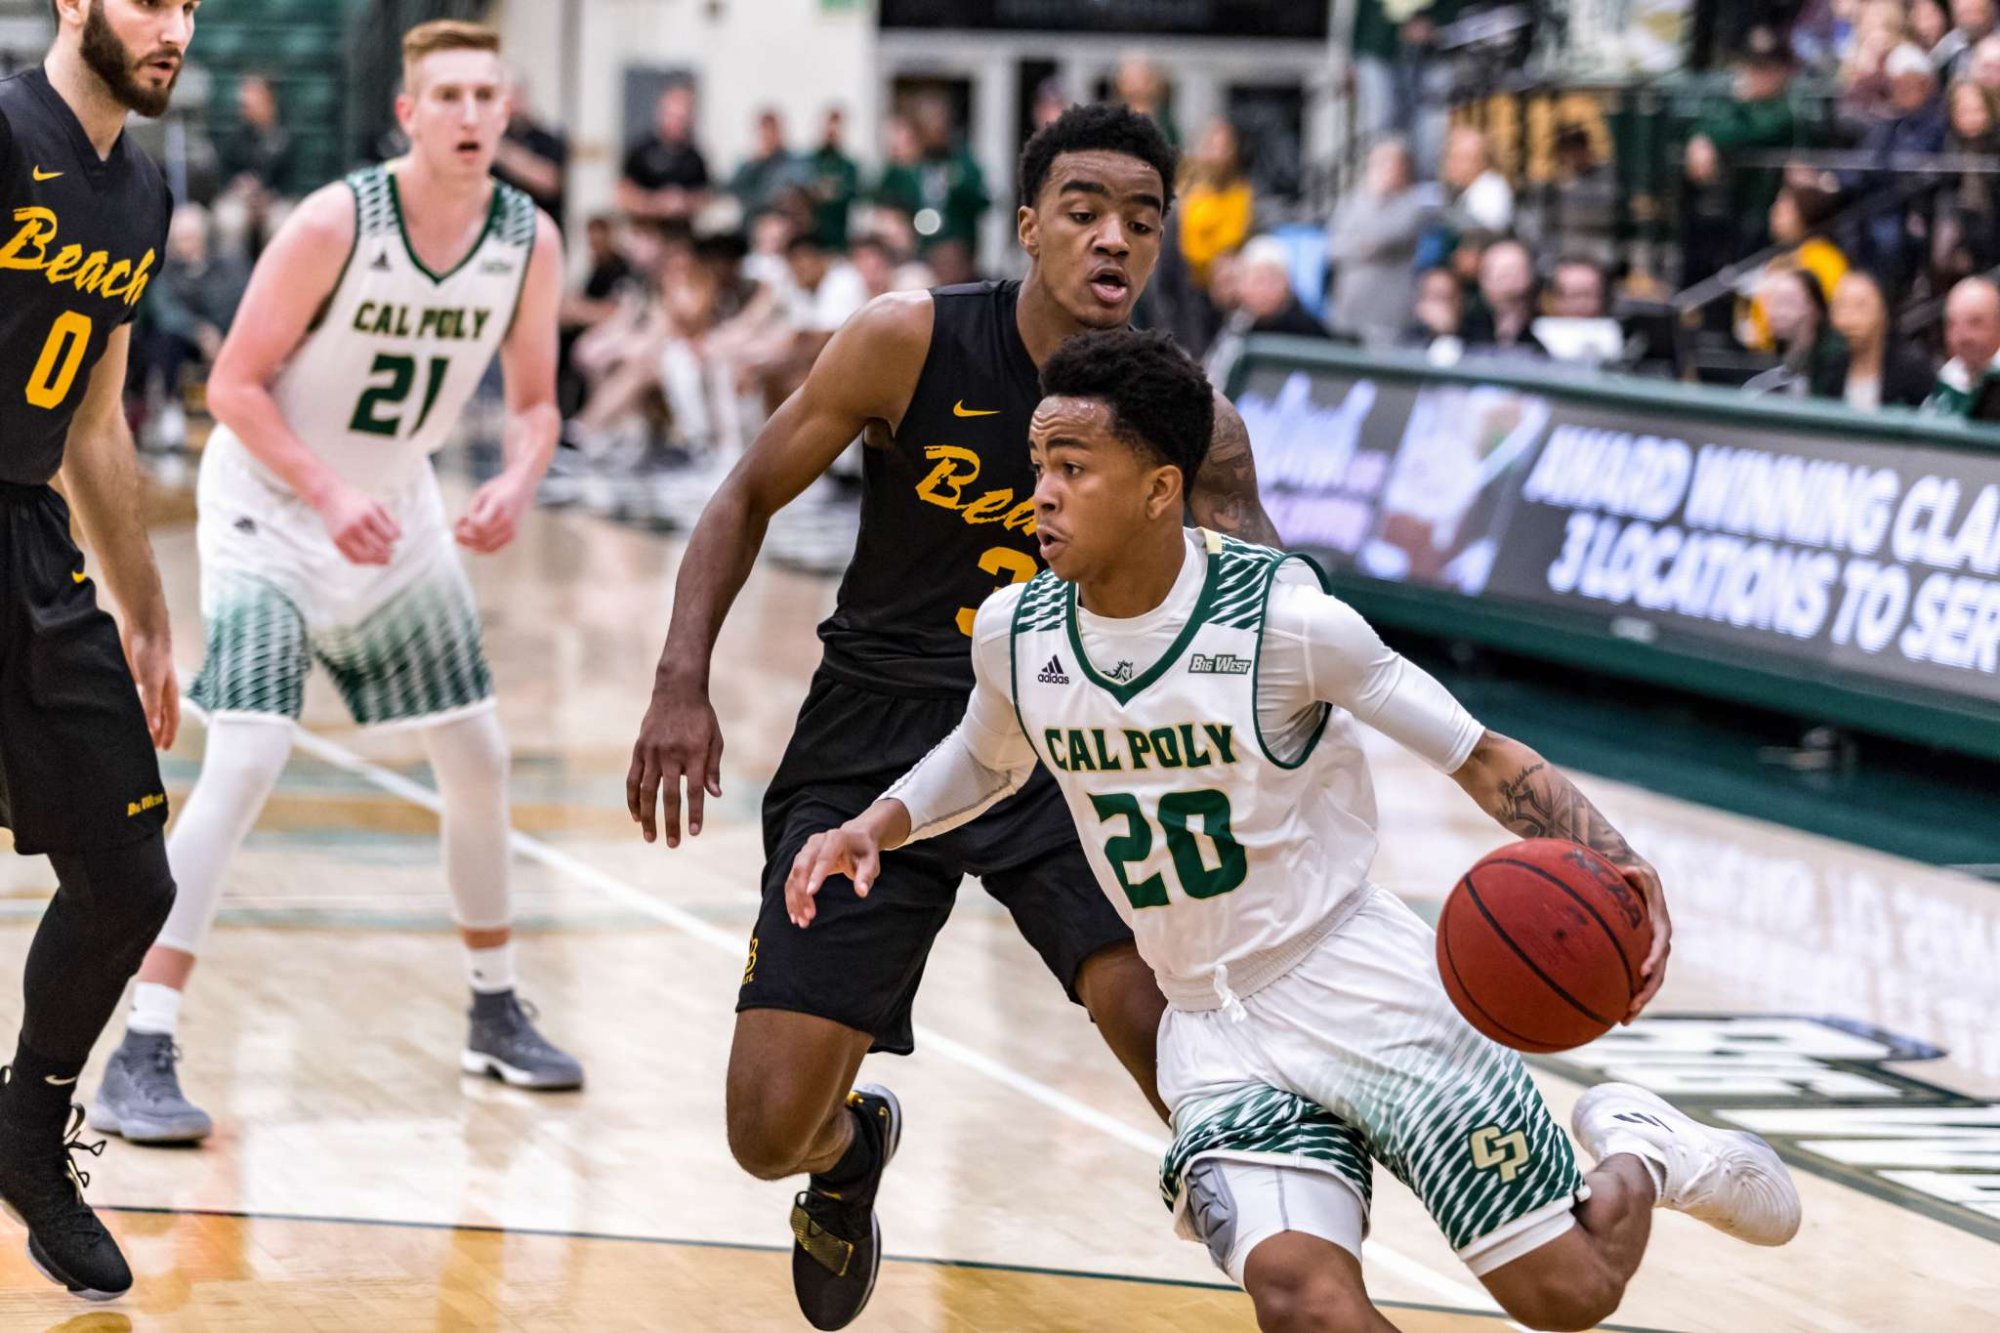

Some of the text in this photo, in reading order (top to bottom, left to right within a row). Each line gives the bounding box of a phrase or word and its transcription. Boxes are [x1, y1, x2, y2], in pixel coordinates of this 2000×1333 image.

[0, 206, 156, 306] Beach
[25, 310, 92, 410] 0
[352, 301, 491, 340] CAL POLY
[347, 353, 451, 440] 21
[915, 444, 1038, 537] Bea
[1523, 424, 2000, 575] AWARD WINNING CLA
[1547, 512, 1600, 594] 3
[1578, 517, 1839, 640] LOCATIONS
[1831, 558, 1911, 654] TO
[1037, 671, 1070, 685] adidas
[1044, 722, 1240, 772] CAL POLY
[1086, 788, 1248, 910] 20
[1470, 1125, 1530, 1184] CP
